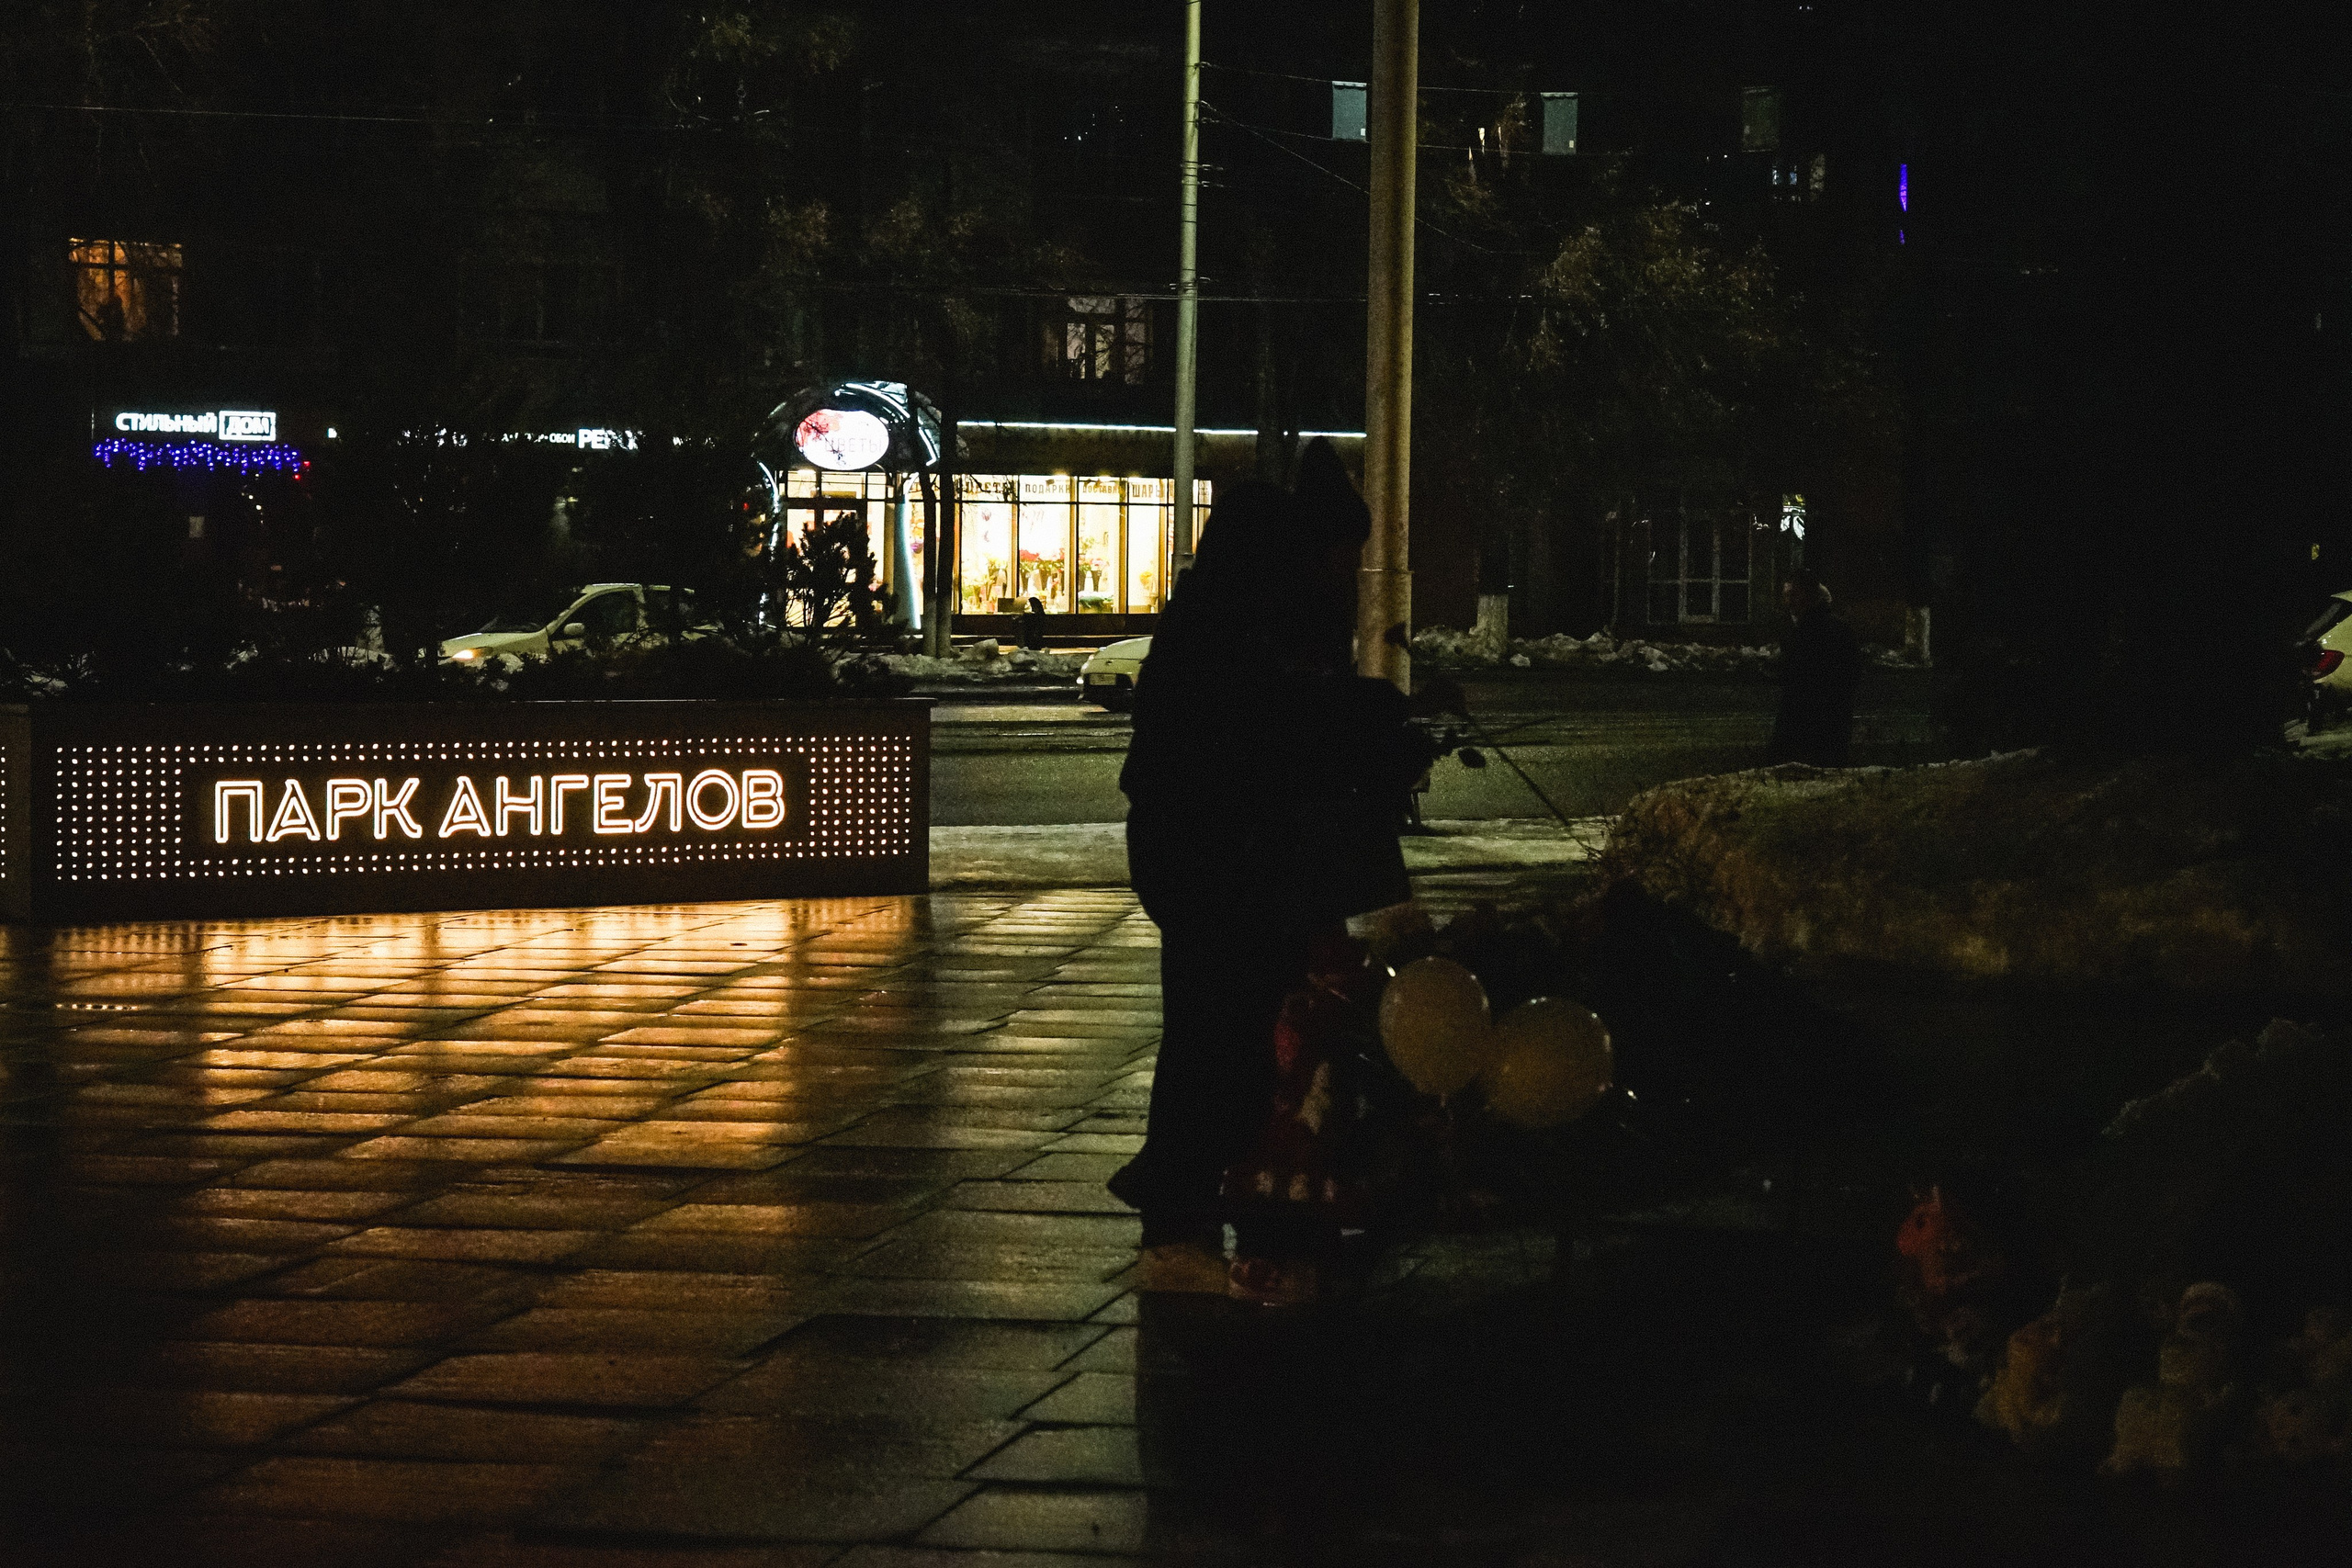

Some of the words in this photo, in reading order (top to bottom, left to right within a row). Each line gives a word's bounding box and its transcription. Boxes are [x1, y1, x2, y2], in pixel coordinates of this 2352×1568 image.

[225, 416, 270, 435] ДОМ
[215, 777, 422, 842] ПАРК
[439, 769, 786, 838] АНГЕЛОВ
